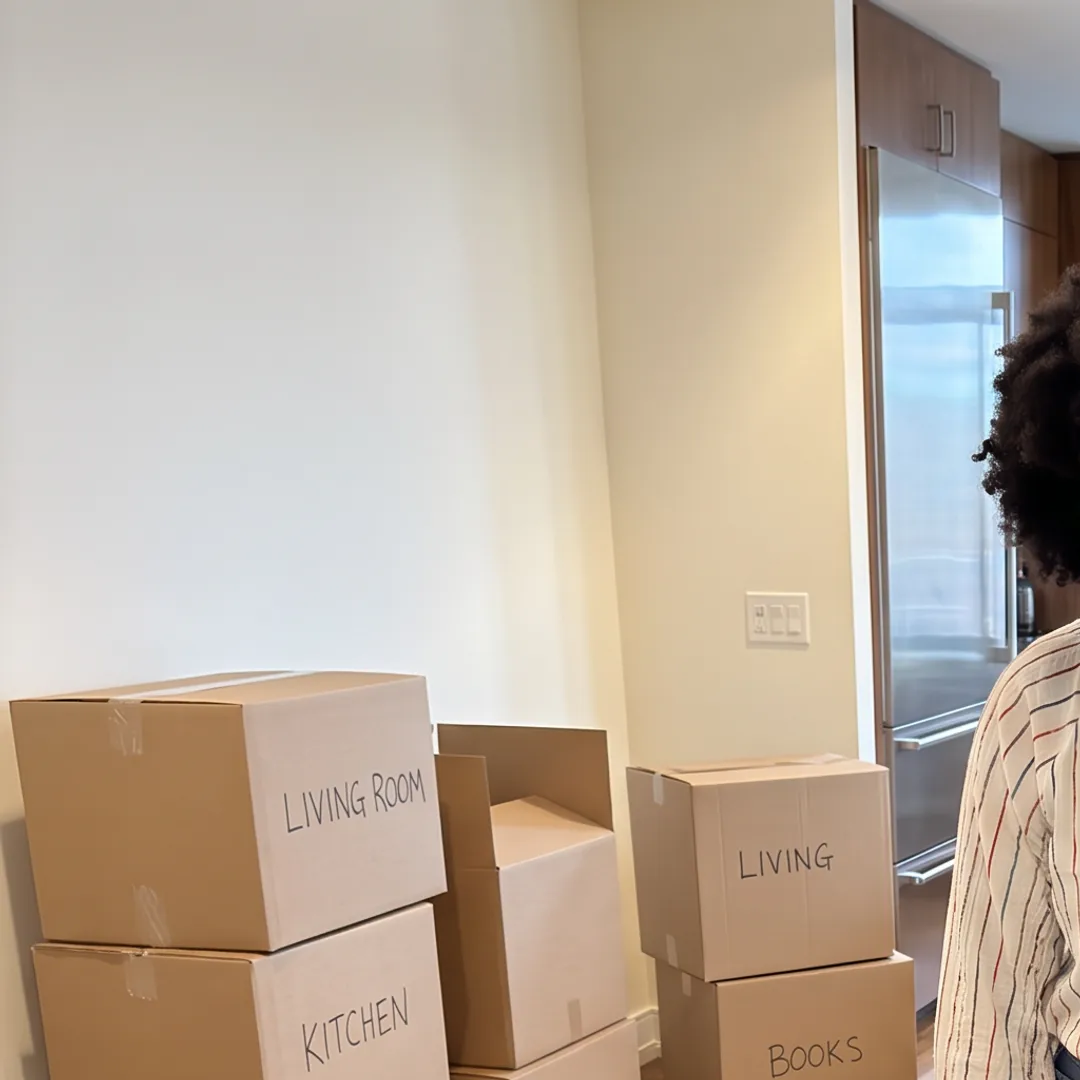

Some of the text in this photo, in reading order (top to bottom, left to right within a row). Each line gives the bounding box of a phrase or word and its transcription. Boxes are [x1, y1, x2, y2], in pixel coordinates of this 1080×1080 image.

[283, 768, 428, 834] LIVING ROOM
[739, 842, 835, 880] LIVING
[301, 986, 409, 1073] KITCHEN
[768, 1035, 864, 1079] BOOKS
